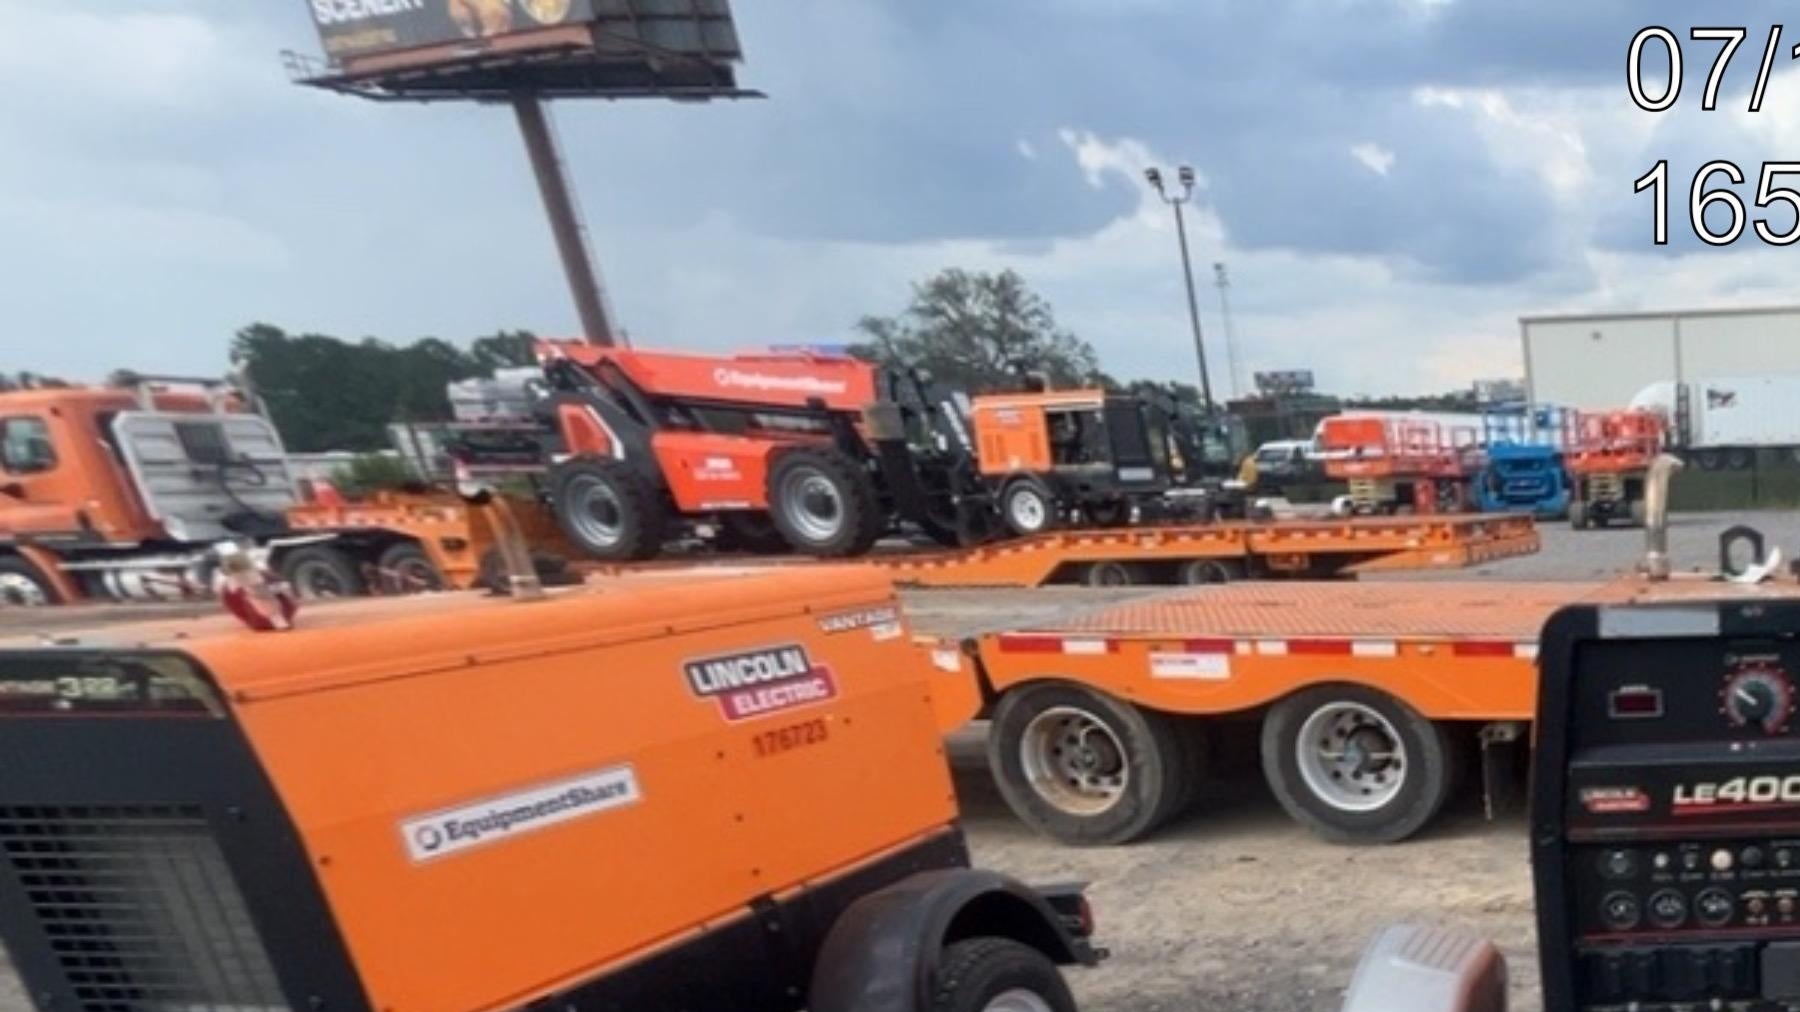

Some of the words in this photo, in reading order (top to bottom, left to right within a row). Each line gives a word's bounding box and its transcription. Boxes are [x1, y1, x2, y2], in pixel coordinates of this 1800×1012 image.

[690, 649, 808, 694] LINCOLN
[733, 677, 830, 716] ELECTRIC
[443, 781, 629, 842] EquipmentShare
